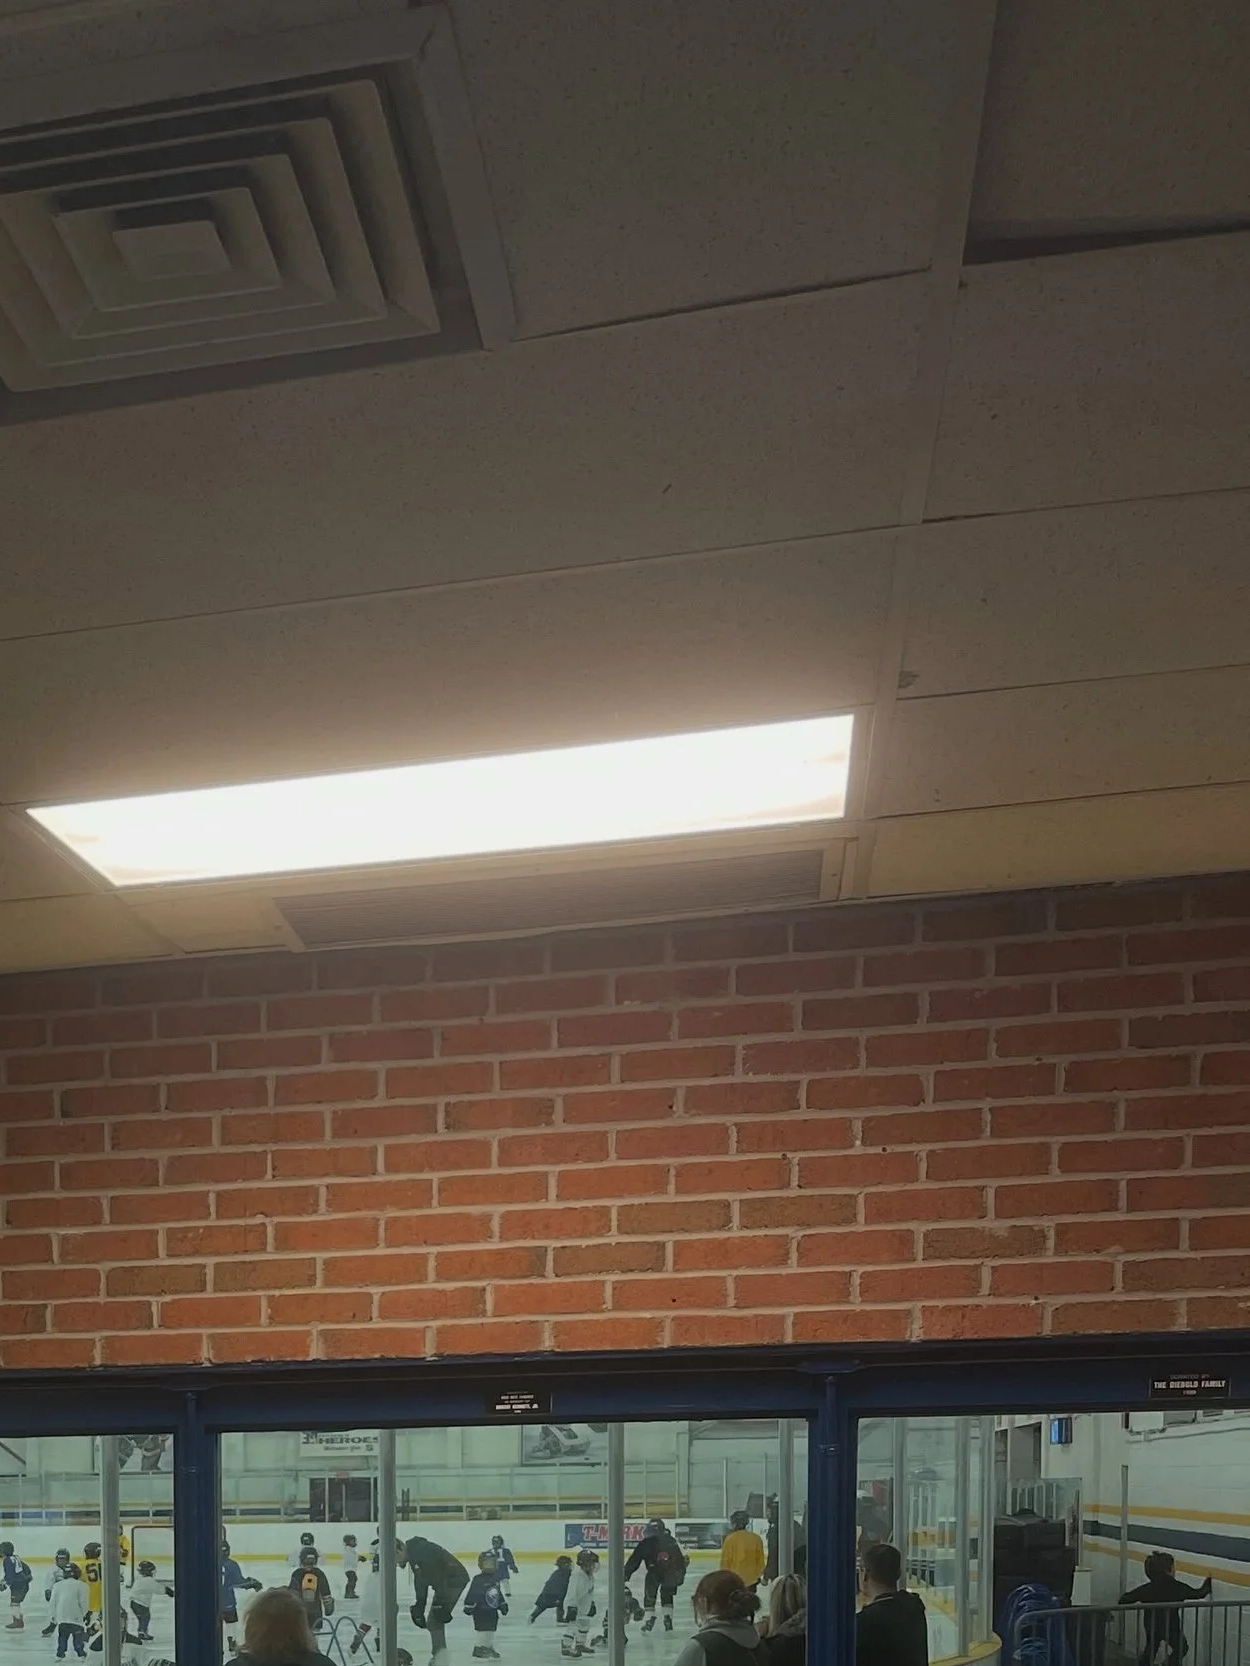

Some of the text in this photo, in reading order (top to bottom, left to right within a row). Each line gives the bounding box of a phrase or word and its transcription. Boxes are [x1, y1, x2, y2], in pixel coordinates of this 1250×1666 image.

[1154, 1381, 1167, 1389] THE
[1201, 1380, 1226, 1388] FAMILY
[582, 1524, 647, 1542] T-MRK
